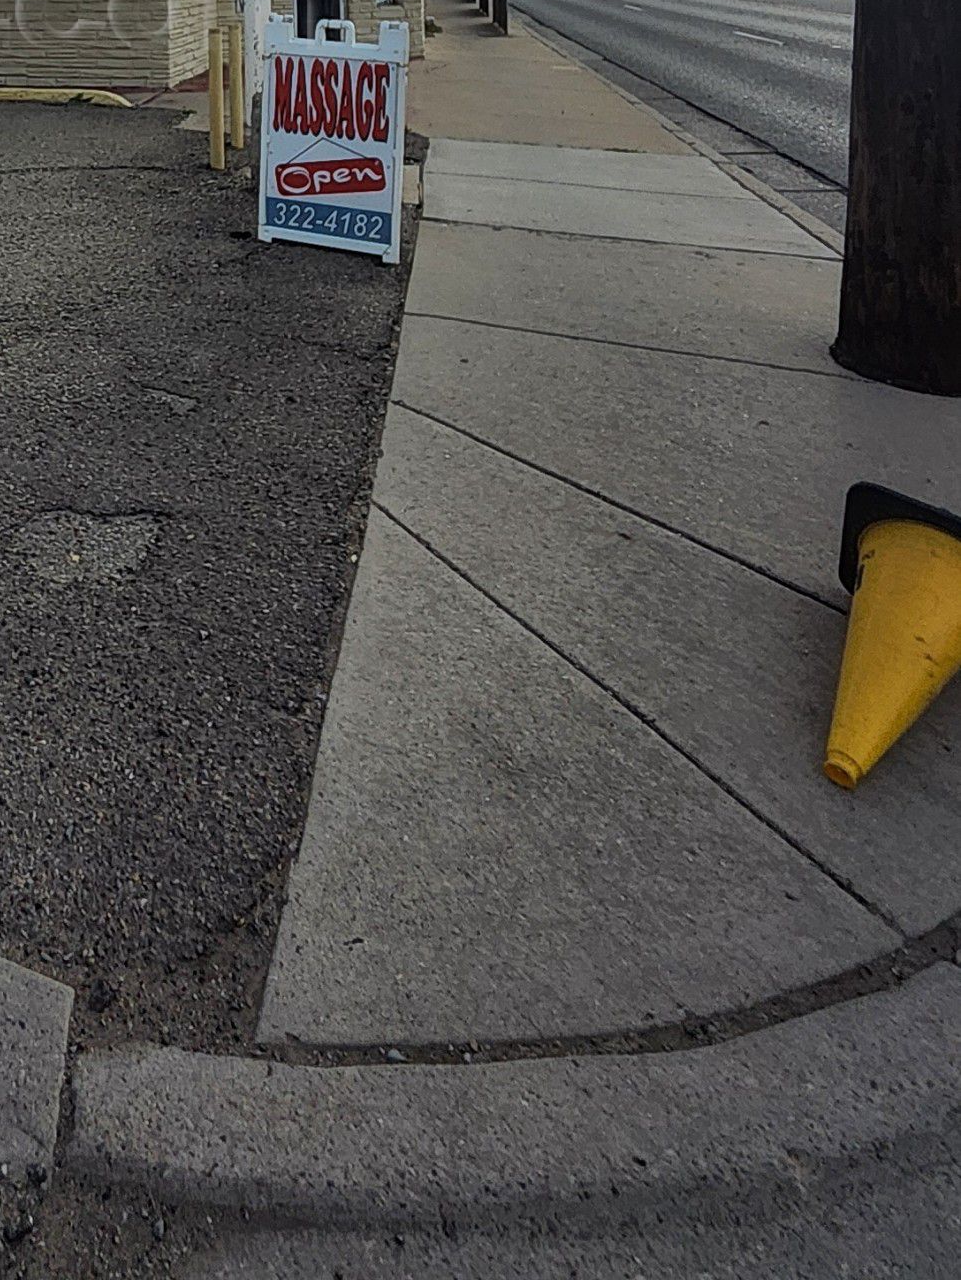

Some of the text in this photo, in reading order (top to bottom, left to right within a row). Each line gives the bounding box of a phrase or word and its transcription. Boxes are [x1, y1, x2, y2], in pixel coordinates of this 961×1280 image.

[273, 55, 391, 144] MASSAGE
[280, 166, 383, 194] Open
[274, 202, 384, 240] 322-4182
